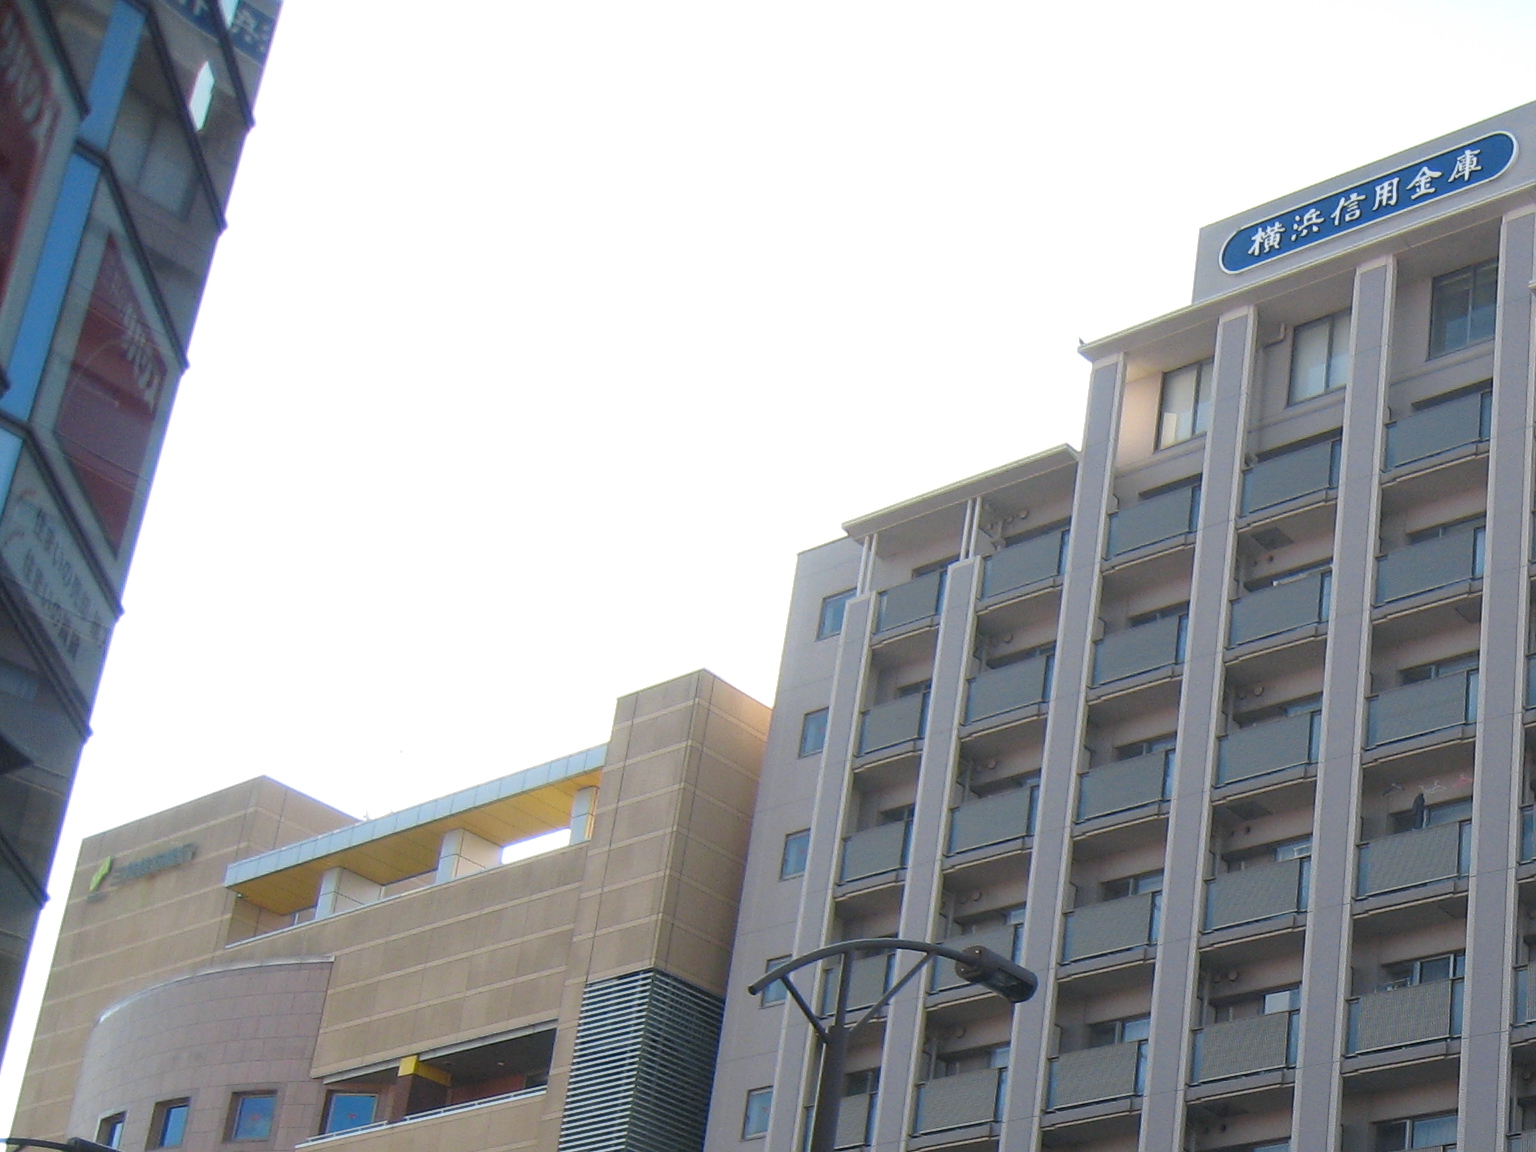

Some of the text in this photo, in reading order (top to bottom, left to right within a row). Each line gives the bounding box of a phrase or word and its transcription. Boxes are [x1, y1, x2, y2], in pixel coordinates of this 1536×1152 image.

[1247, 147, 1483, 258] 横浜信用金庫
